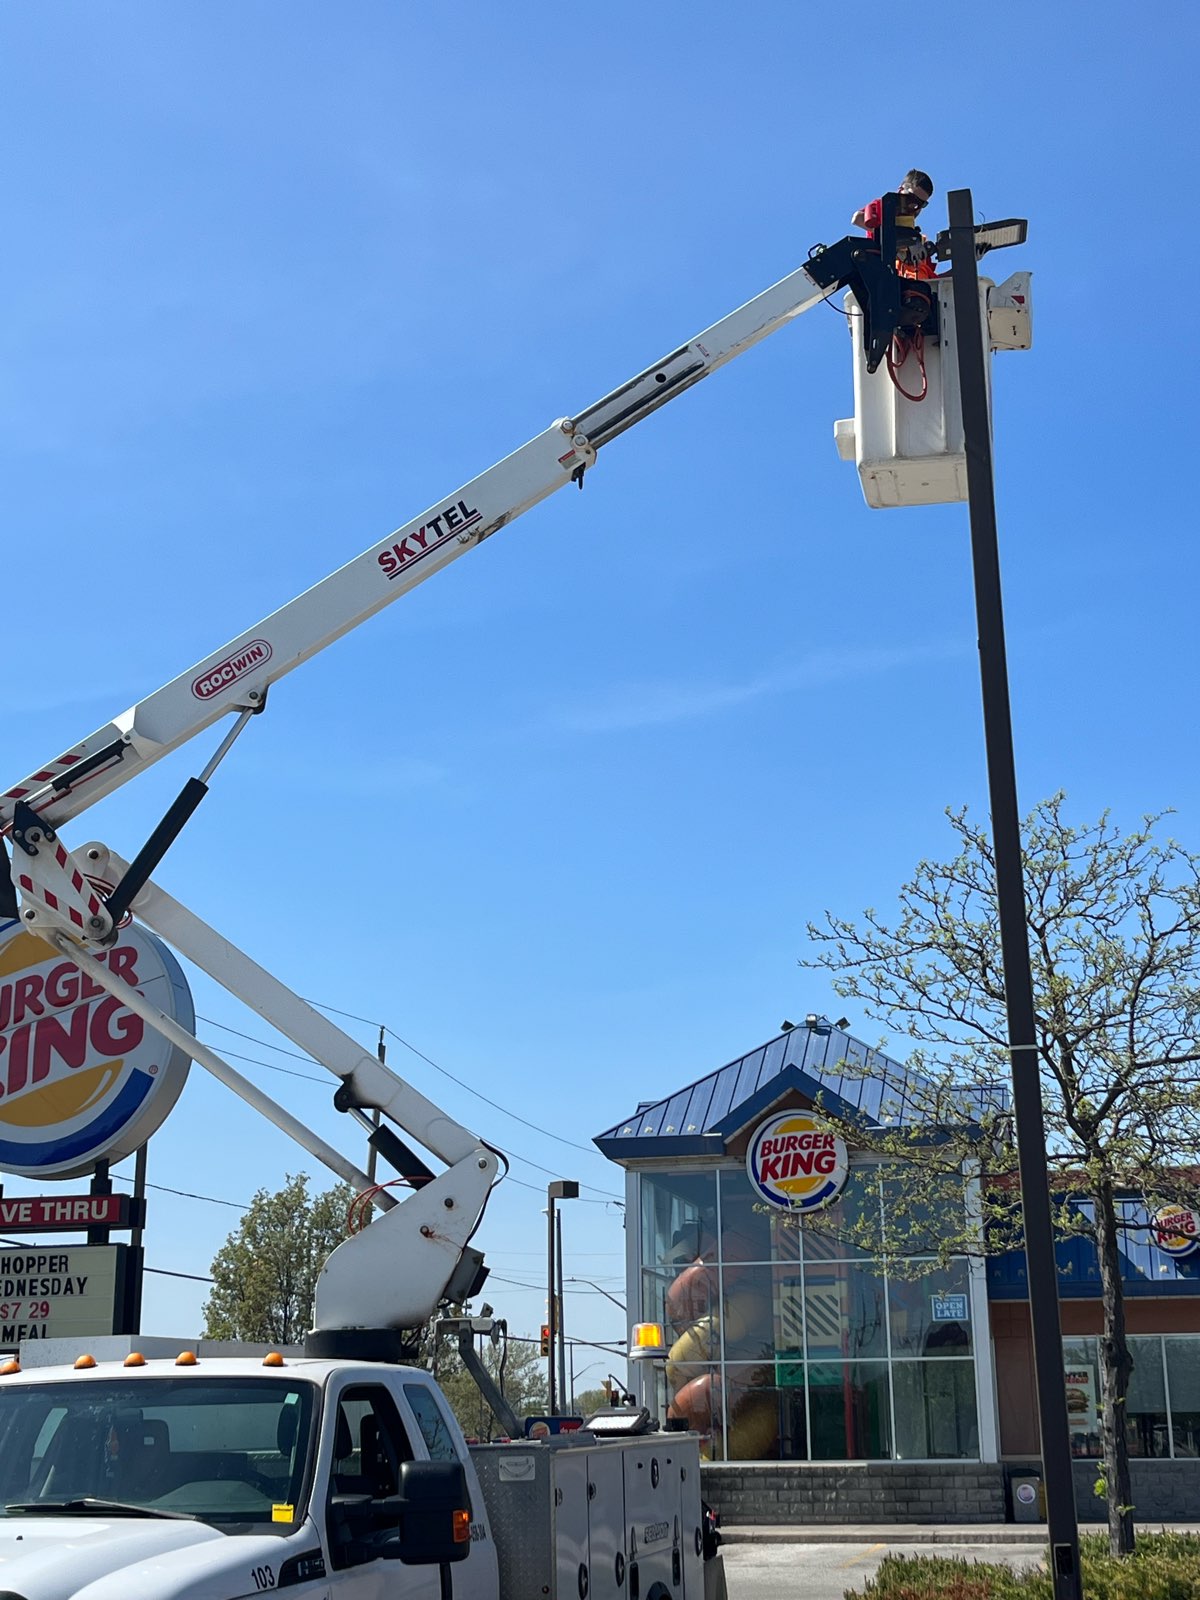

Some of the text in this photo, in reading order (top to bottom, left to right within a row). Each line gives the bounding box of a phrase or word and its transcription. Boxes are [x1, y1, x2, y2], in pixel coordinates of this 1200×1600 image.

[377, 500, 479, 573] SKYTEL
[199, 646, 264, 695] ROCWIN
[0, 988, 145, 1098] ING
[760, 1133, 836, 1158] BURGER
[760, 1150, 837, 1184] KING
[40, 1200, 109, 1222] THRU
[1, 1255, 69, 1275] HOPPER
[0, 1276, 88, 1297] DNESDAY
[935, 1302, 964, 1310] OPEN
[936, 1310, 964, 1318] LATE
[2, 1324, 48, 1343] MEAL
[251, 1565, 275, 1590] 103
